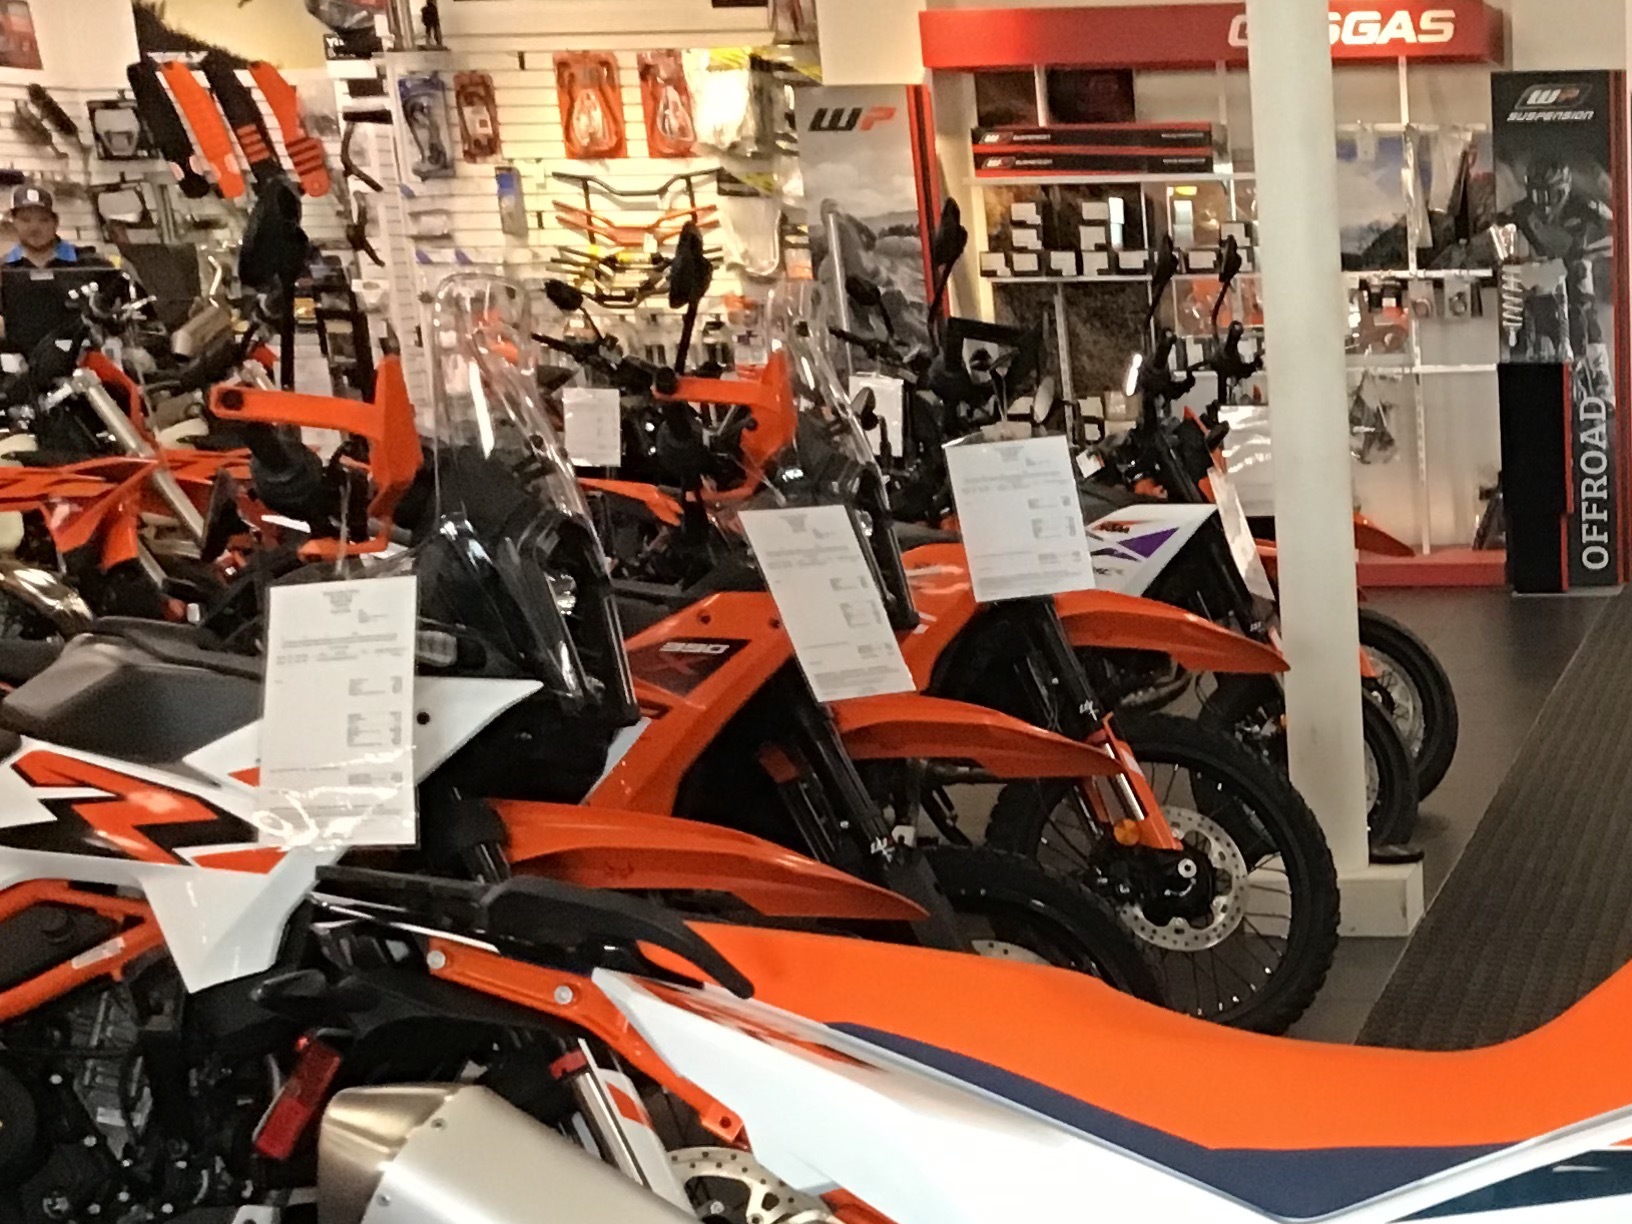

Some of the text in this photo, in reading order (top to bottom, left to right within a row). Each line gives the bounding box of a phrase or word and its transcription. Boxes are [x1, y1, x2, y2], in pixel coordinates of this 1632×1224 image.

[808, 106, 897, 133] WP
[1506, 110, 1595, 122] SUSPENSION
[1579, 396, 1610, 570] OFFROAD
